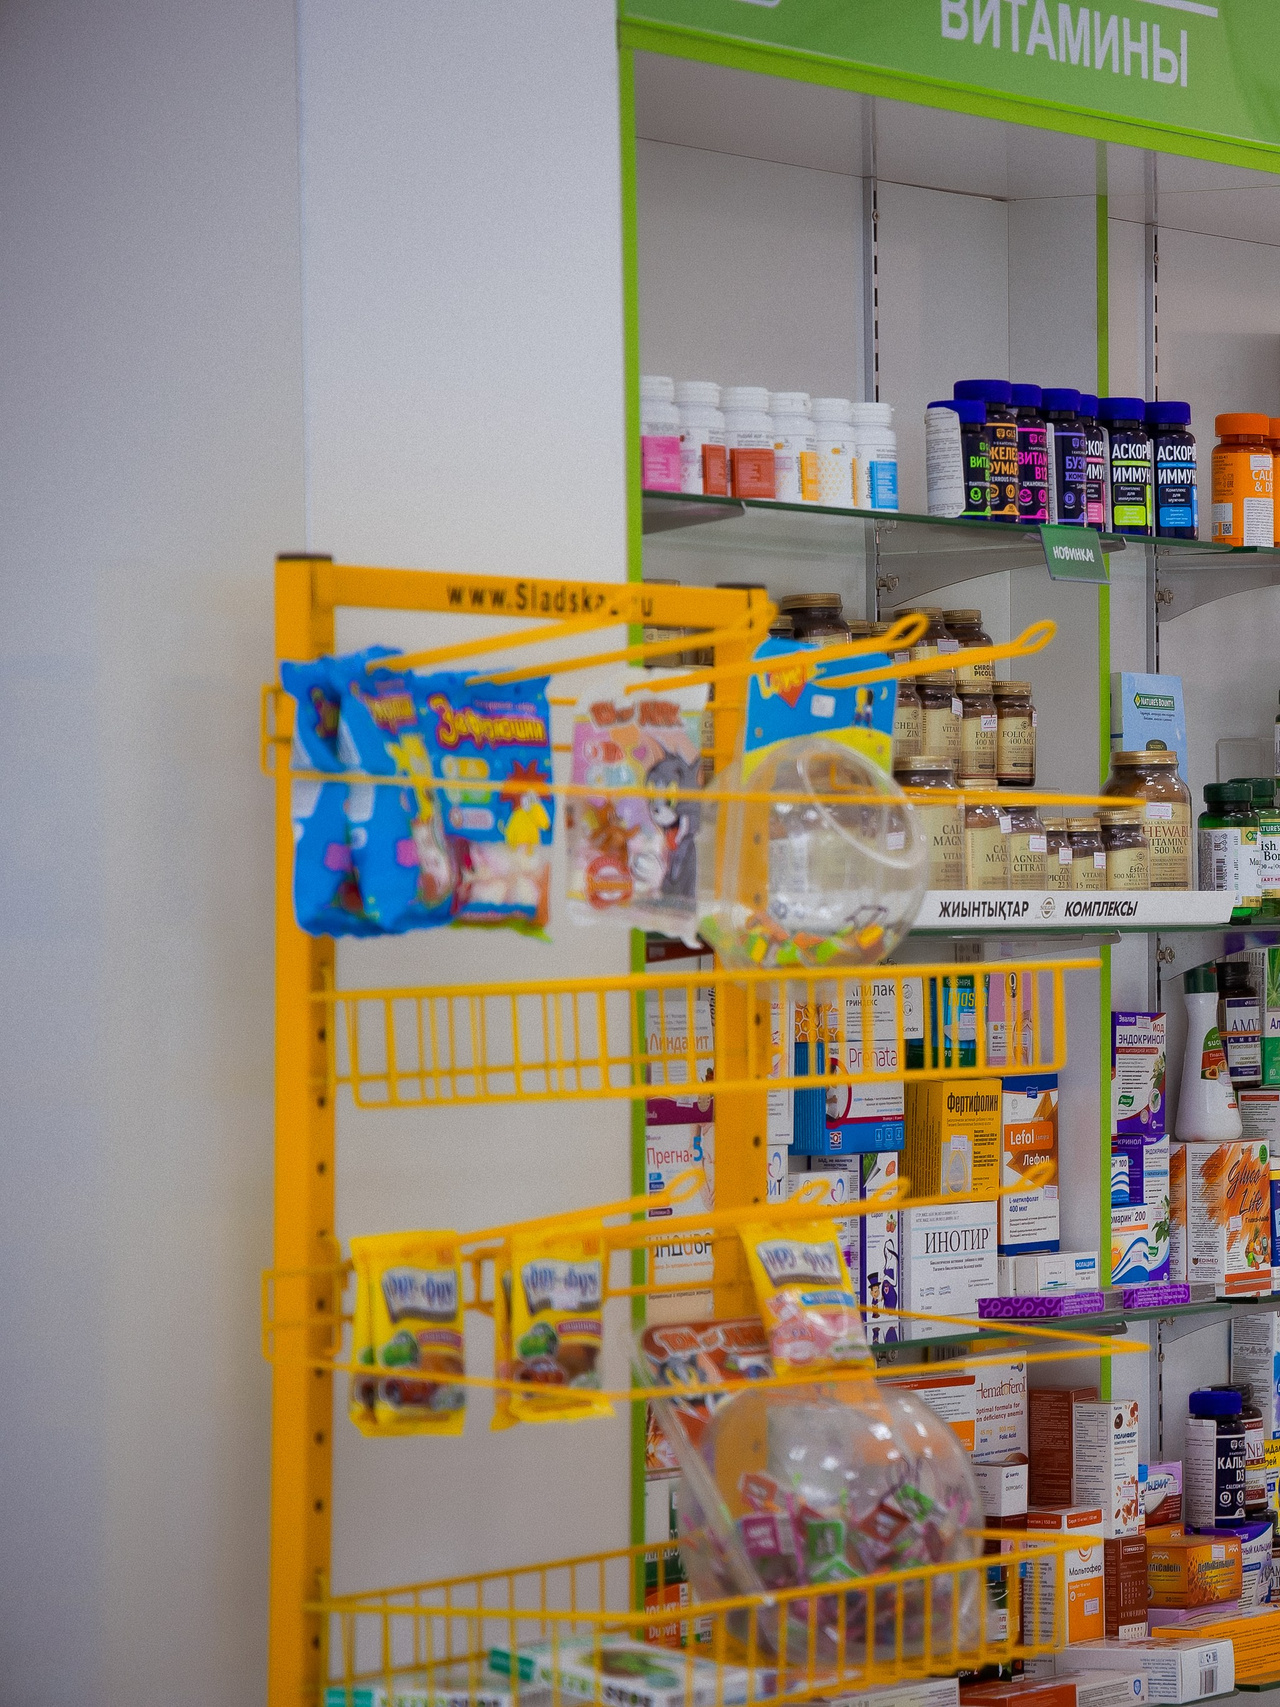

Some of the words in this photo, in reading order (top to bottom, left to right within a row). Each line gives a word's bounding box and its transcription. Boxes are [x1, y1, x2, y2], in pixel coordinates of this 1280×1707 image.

[939, 0, 1189, 87] ВИТАМИНЫ
[1052, 545, 1095, 563] НОВИНКА!
[938, 900, 1029, 920] ЖИЫНТЫҚТАР
[1064, 900, 1138, 917] КОМПЛЕКСЫ
[1152, 1022, 1165, 1033] ЙОД
[1118, 1033, 1165, 1045] ЭНДОКРИНОЛ
[946, 1091, 999, 1117] Фертифолин
[1010, 1128, 1035, 1146] Lefol
[1022, 1153, 1050, 1166] Лефол
[1238, 1187, 1265, 1215] Life
[1134, 1210, 1146, 1222] 200
[924, 1227, 990, 1254] ИНОТИР
[1068, 1563, 1102, 1577] Мальтофер
